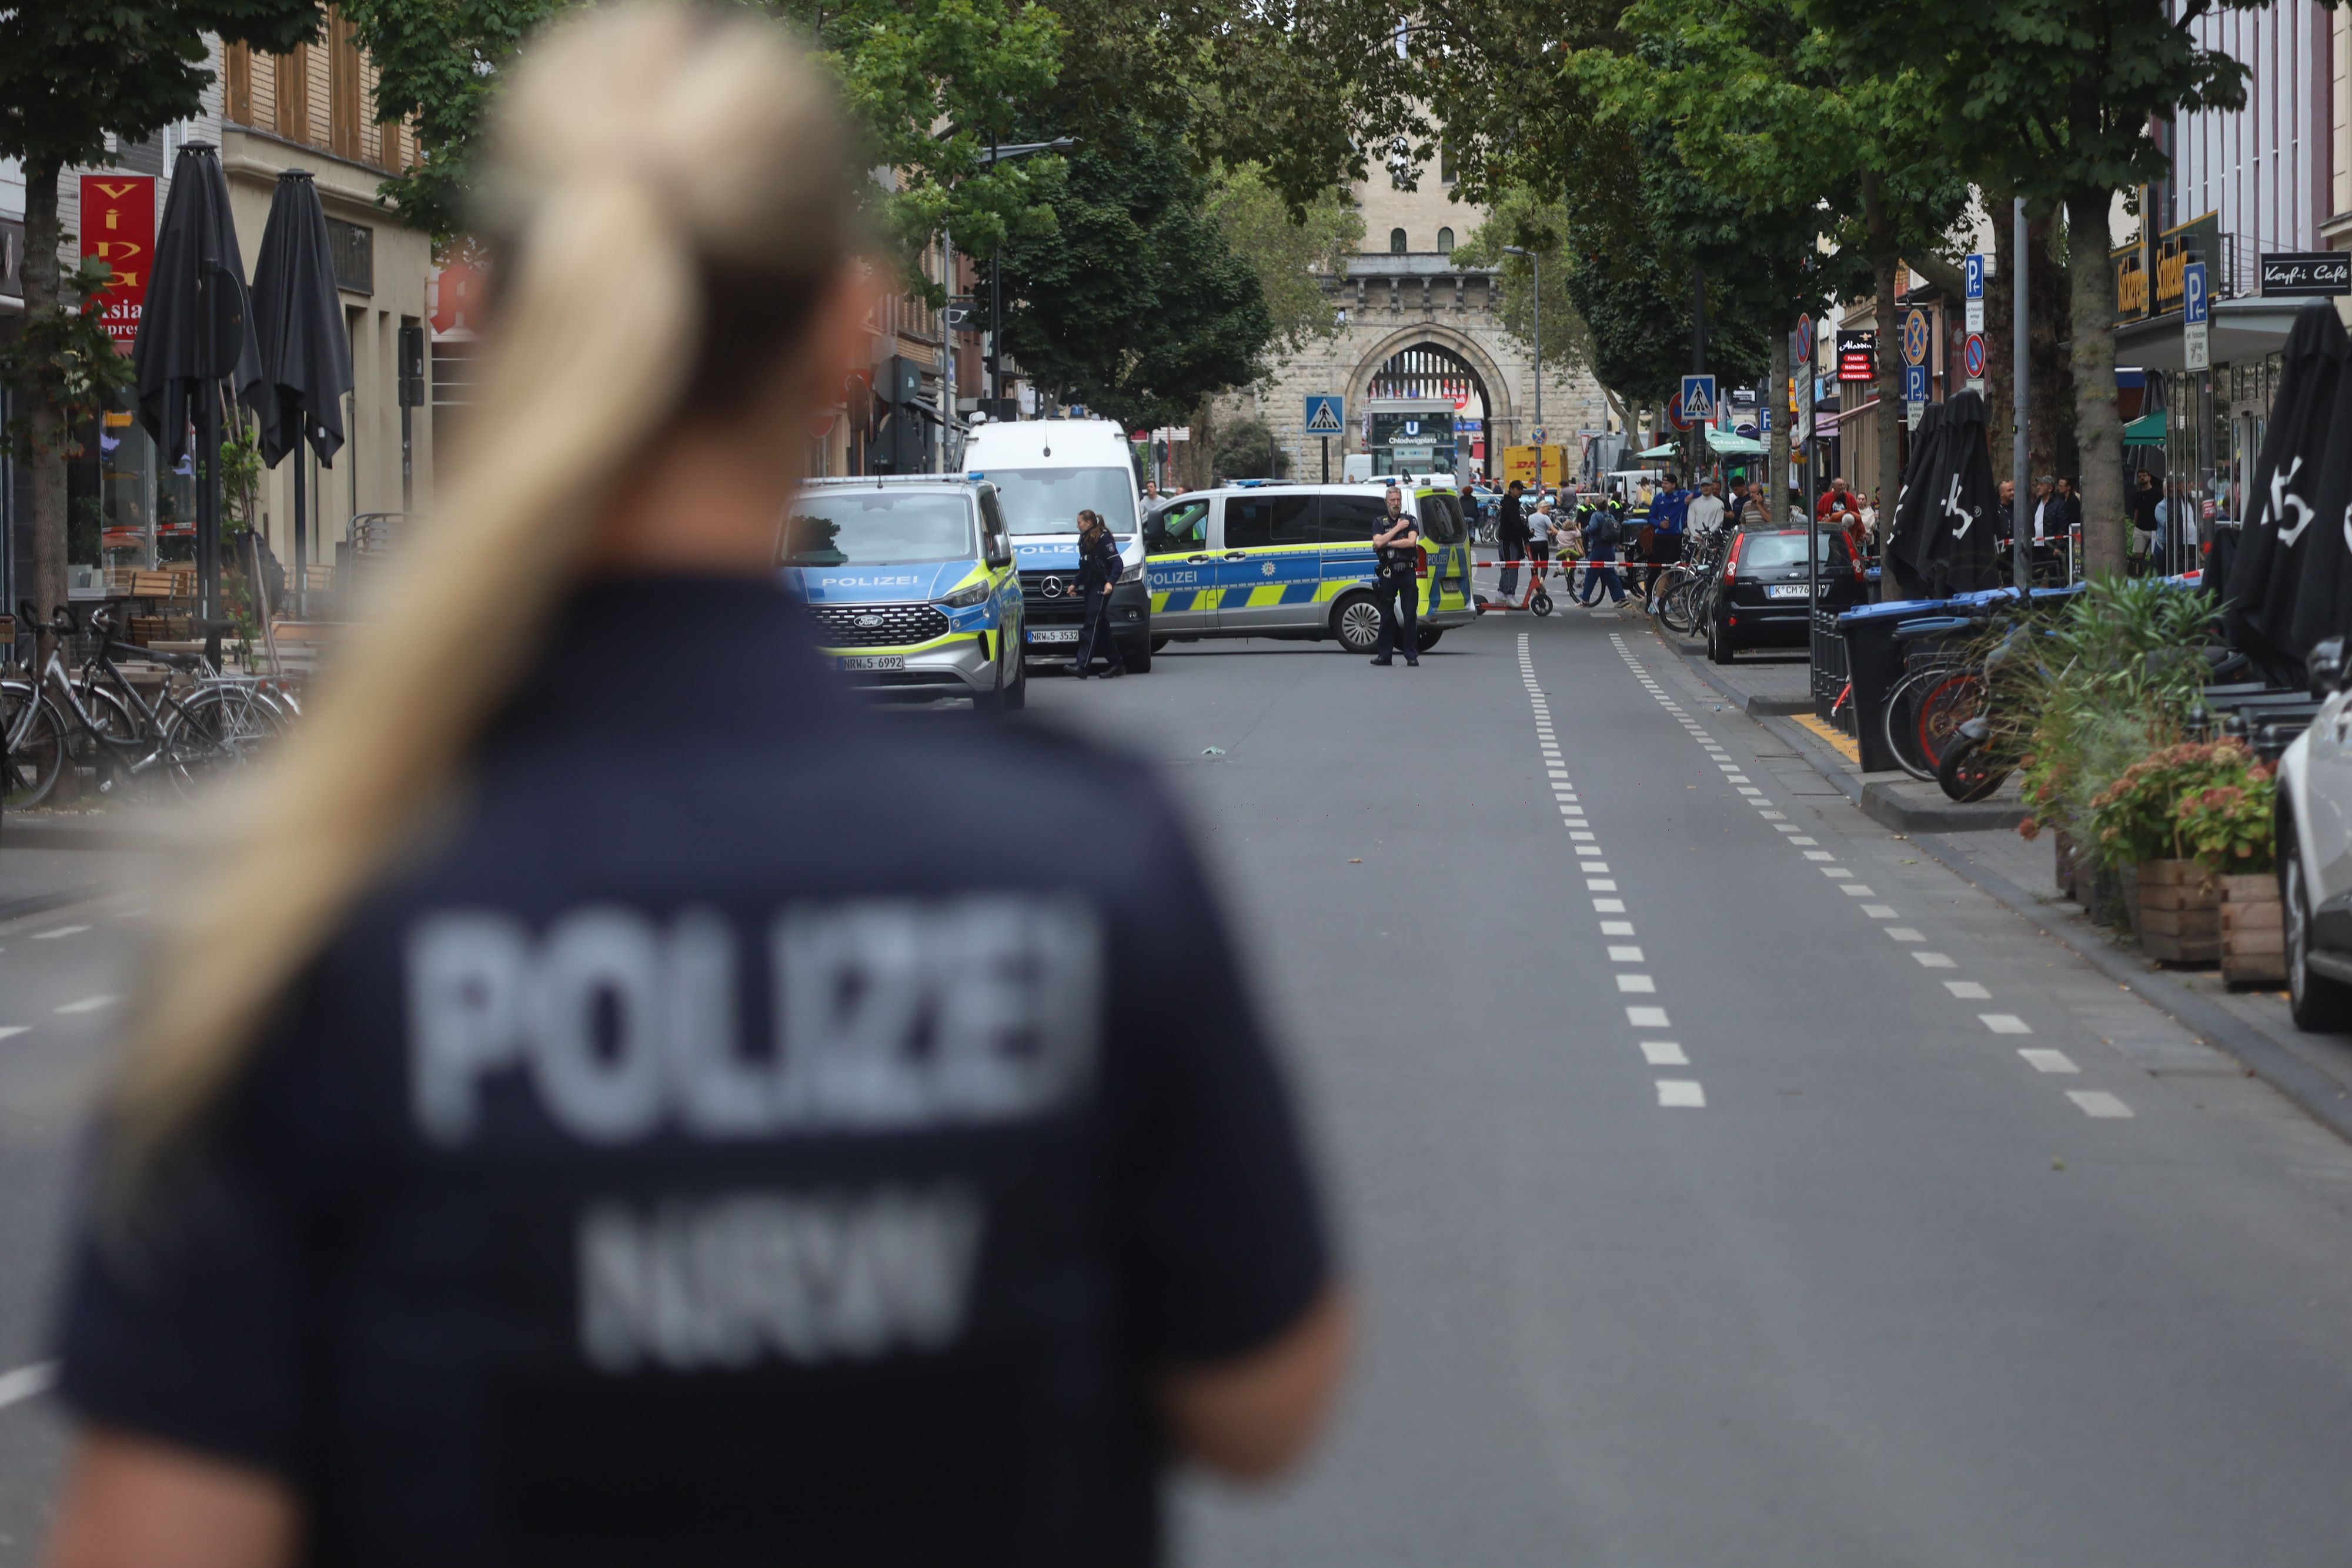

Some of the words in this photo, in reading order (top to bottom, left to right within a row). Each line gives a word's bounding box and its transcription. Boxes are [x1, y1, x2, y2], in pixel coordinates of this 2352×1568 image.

[1969, 260, 1978, 292] P
[2118, 249, 2141, 313] Bäckere
[2264, 266, 2307, 285] Keyf-i
[2314, 265, 2348, 283] Café
[2189, 273, 2201, 320] P
[1911, 372, 1920, 400] P
[1405, 421, 1419, 435] U
[1388, 437, 1437, 445] Chlodwigplatz
[1013, 545, 1080, 554] OLIZ
[1427, 554, 1448, 564] POLIZEI
[822, 576, 918, 586] POLIZEI
[1147, 571, 1197, 585] POLIZEI
[858, 617, 878, 626] Ford
[1031, 632, 1046, 641] NRW
[844, 658, 861, 669] NRW
[407, 891, 1104, 1148] POLIZEI
